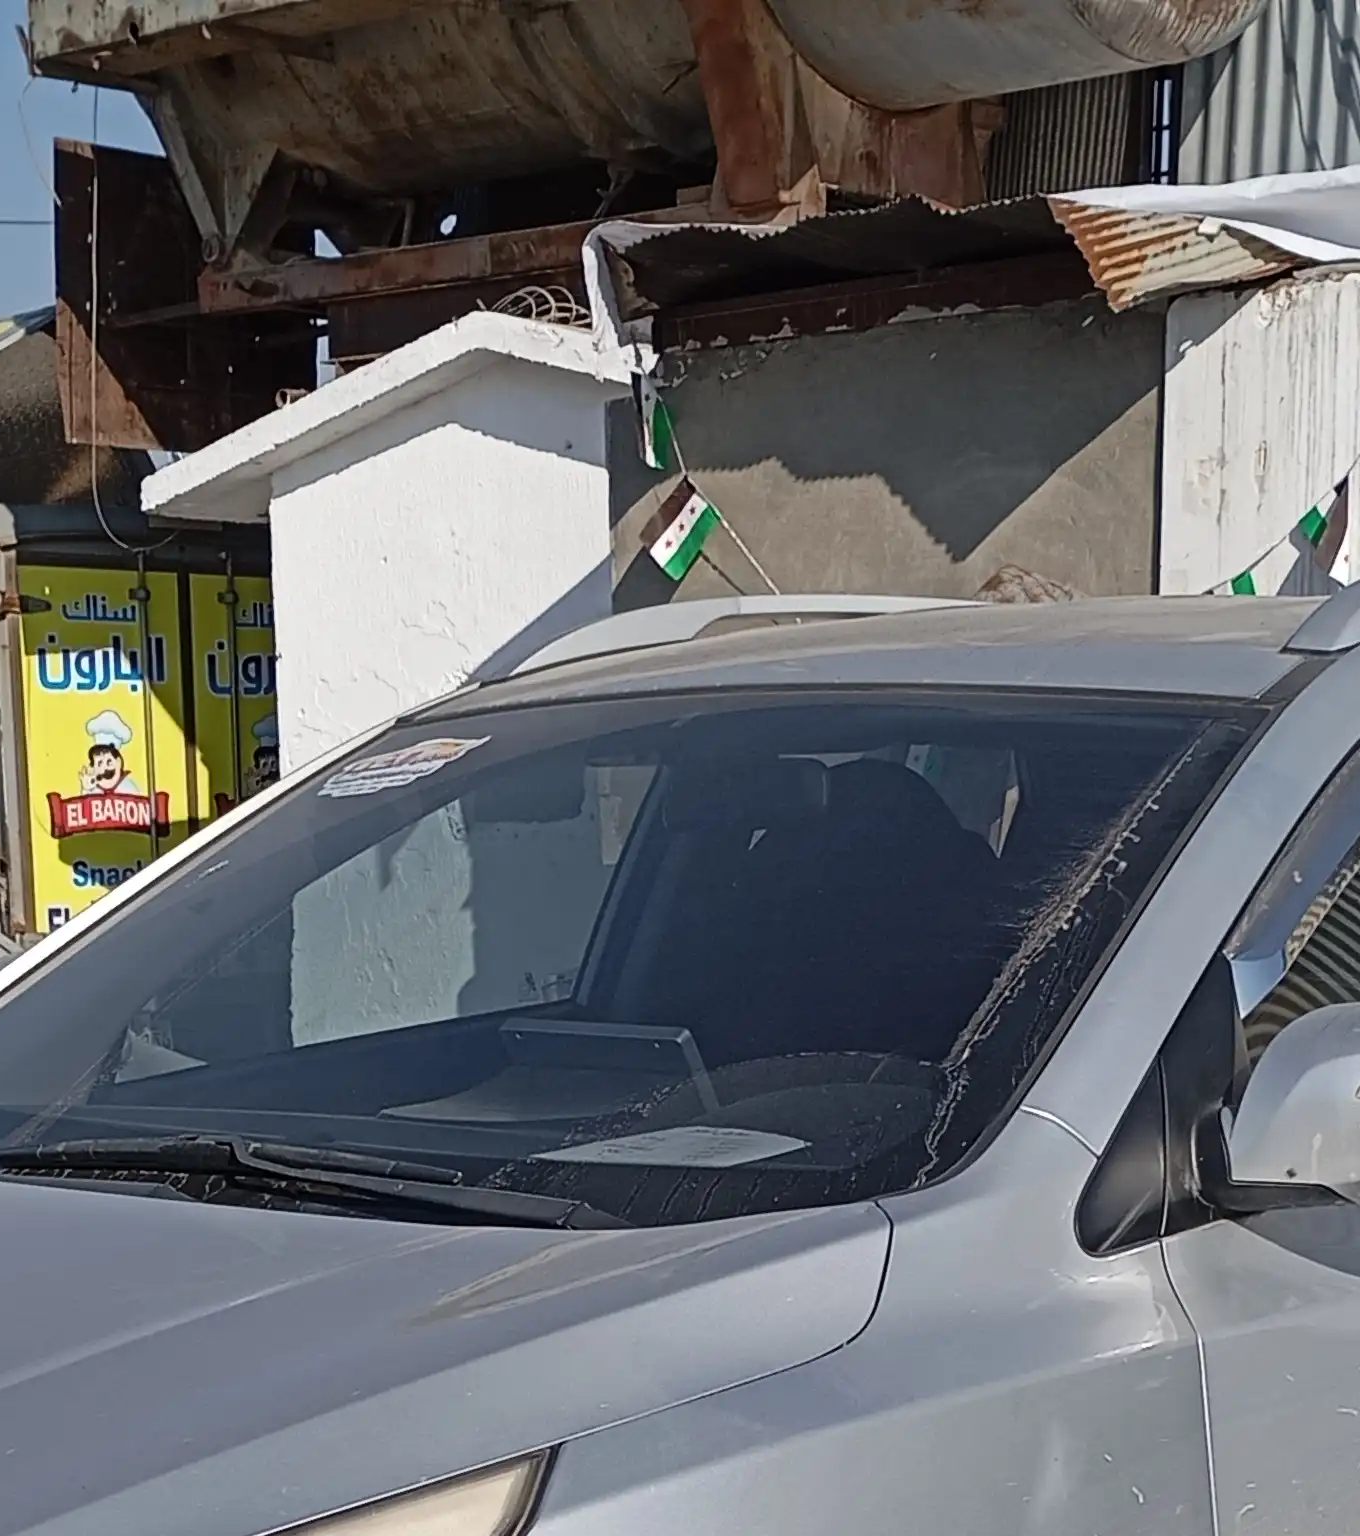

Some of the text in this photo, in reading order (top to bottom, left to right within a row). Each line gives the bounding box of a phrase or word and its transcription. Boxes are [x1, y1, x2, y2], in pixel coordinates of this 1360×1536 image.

[62, 595, 137, 621] سناك
[236, 603, 273, 627] ناك
[37, 634, 165, 691] البارون
[66, 798, 151, 828] EL BARON
[72, 859, 142, 887] Snac
